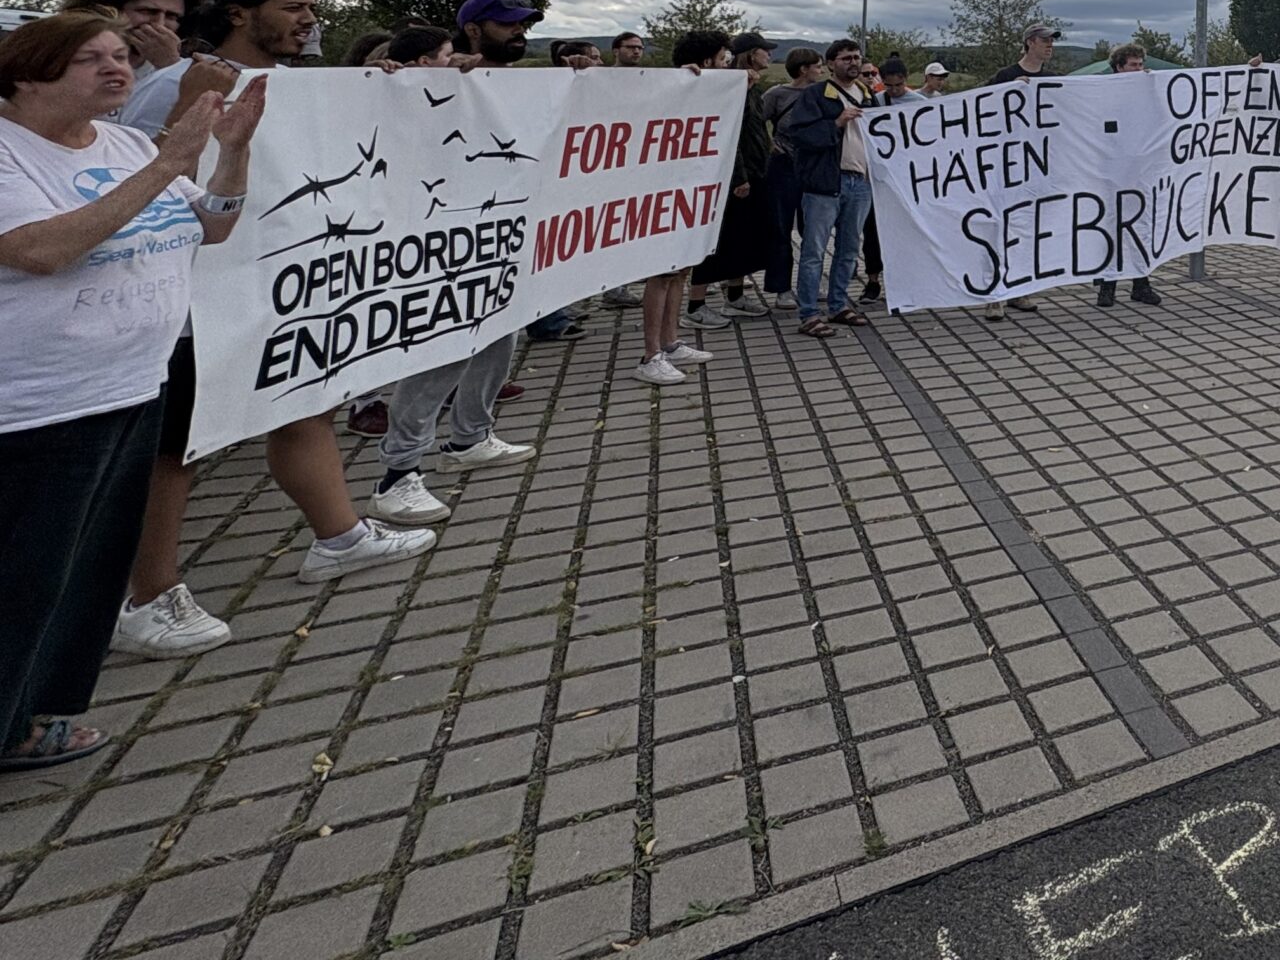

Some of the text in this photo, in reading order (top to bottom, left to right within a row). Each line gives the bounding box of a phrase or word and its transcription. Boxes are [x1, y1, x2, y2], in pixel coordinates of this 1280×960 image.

[559, 115, 721, 179] FOR FREE
[868, 82, 1064, 160] SICHERE
[909, 135, 1049, 205] HÄFEN
[271, 215, 527, 317] OPEN BORDERS
[530, 181, 723, 276] MOVEMENT!
[254, 265, 519, 391] END DEATHS
